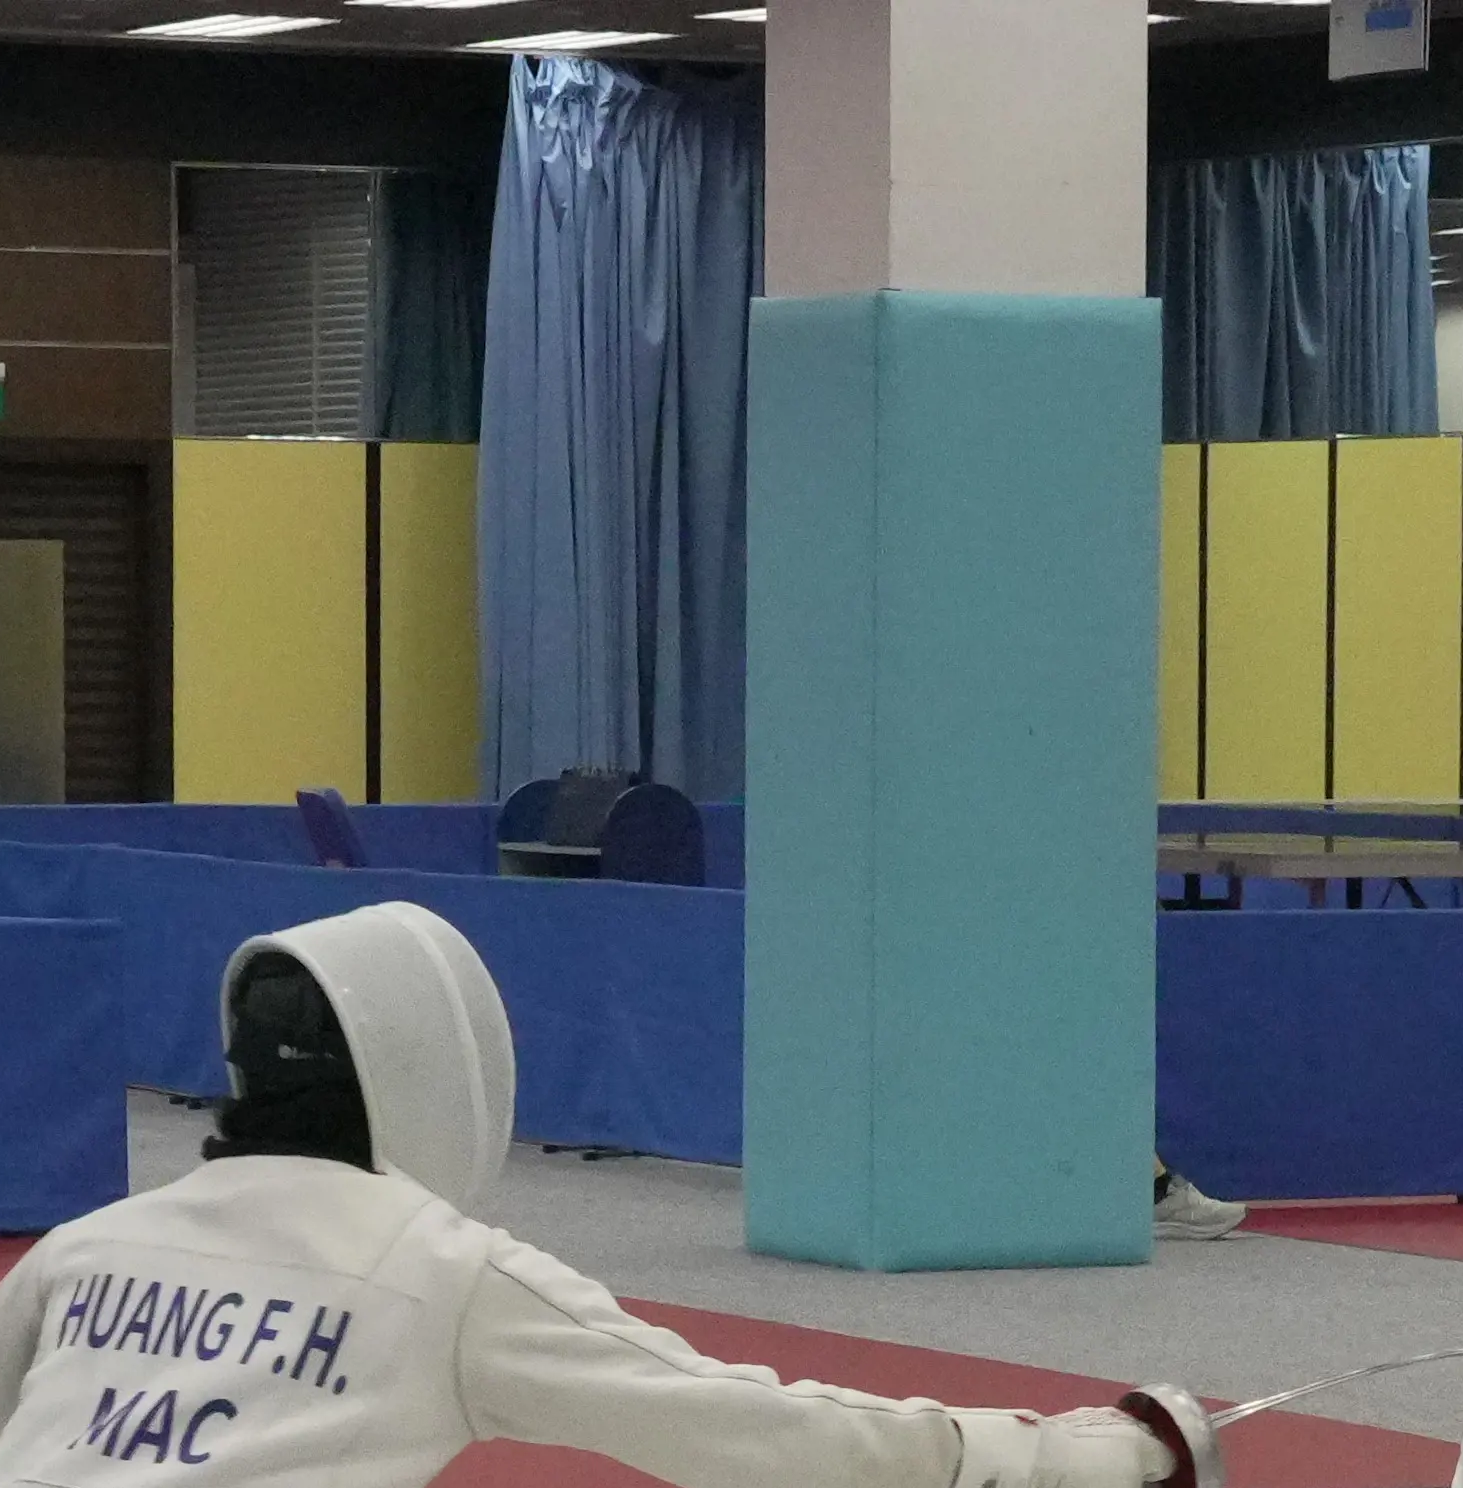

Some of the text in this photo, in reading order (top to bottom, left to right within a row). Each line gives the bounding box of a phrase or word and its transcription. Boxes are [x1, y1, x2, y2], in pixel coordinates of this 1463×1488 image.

[57, 1273, 352, 1395] HUANG F.H.
[67, 1387, 239, 1464] MAC
